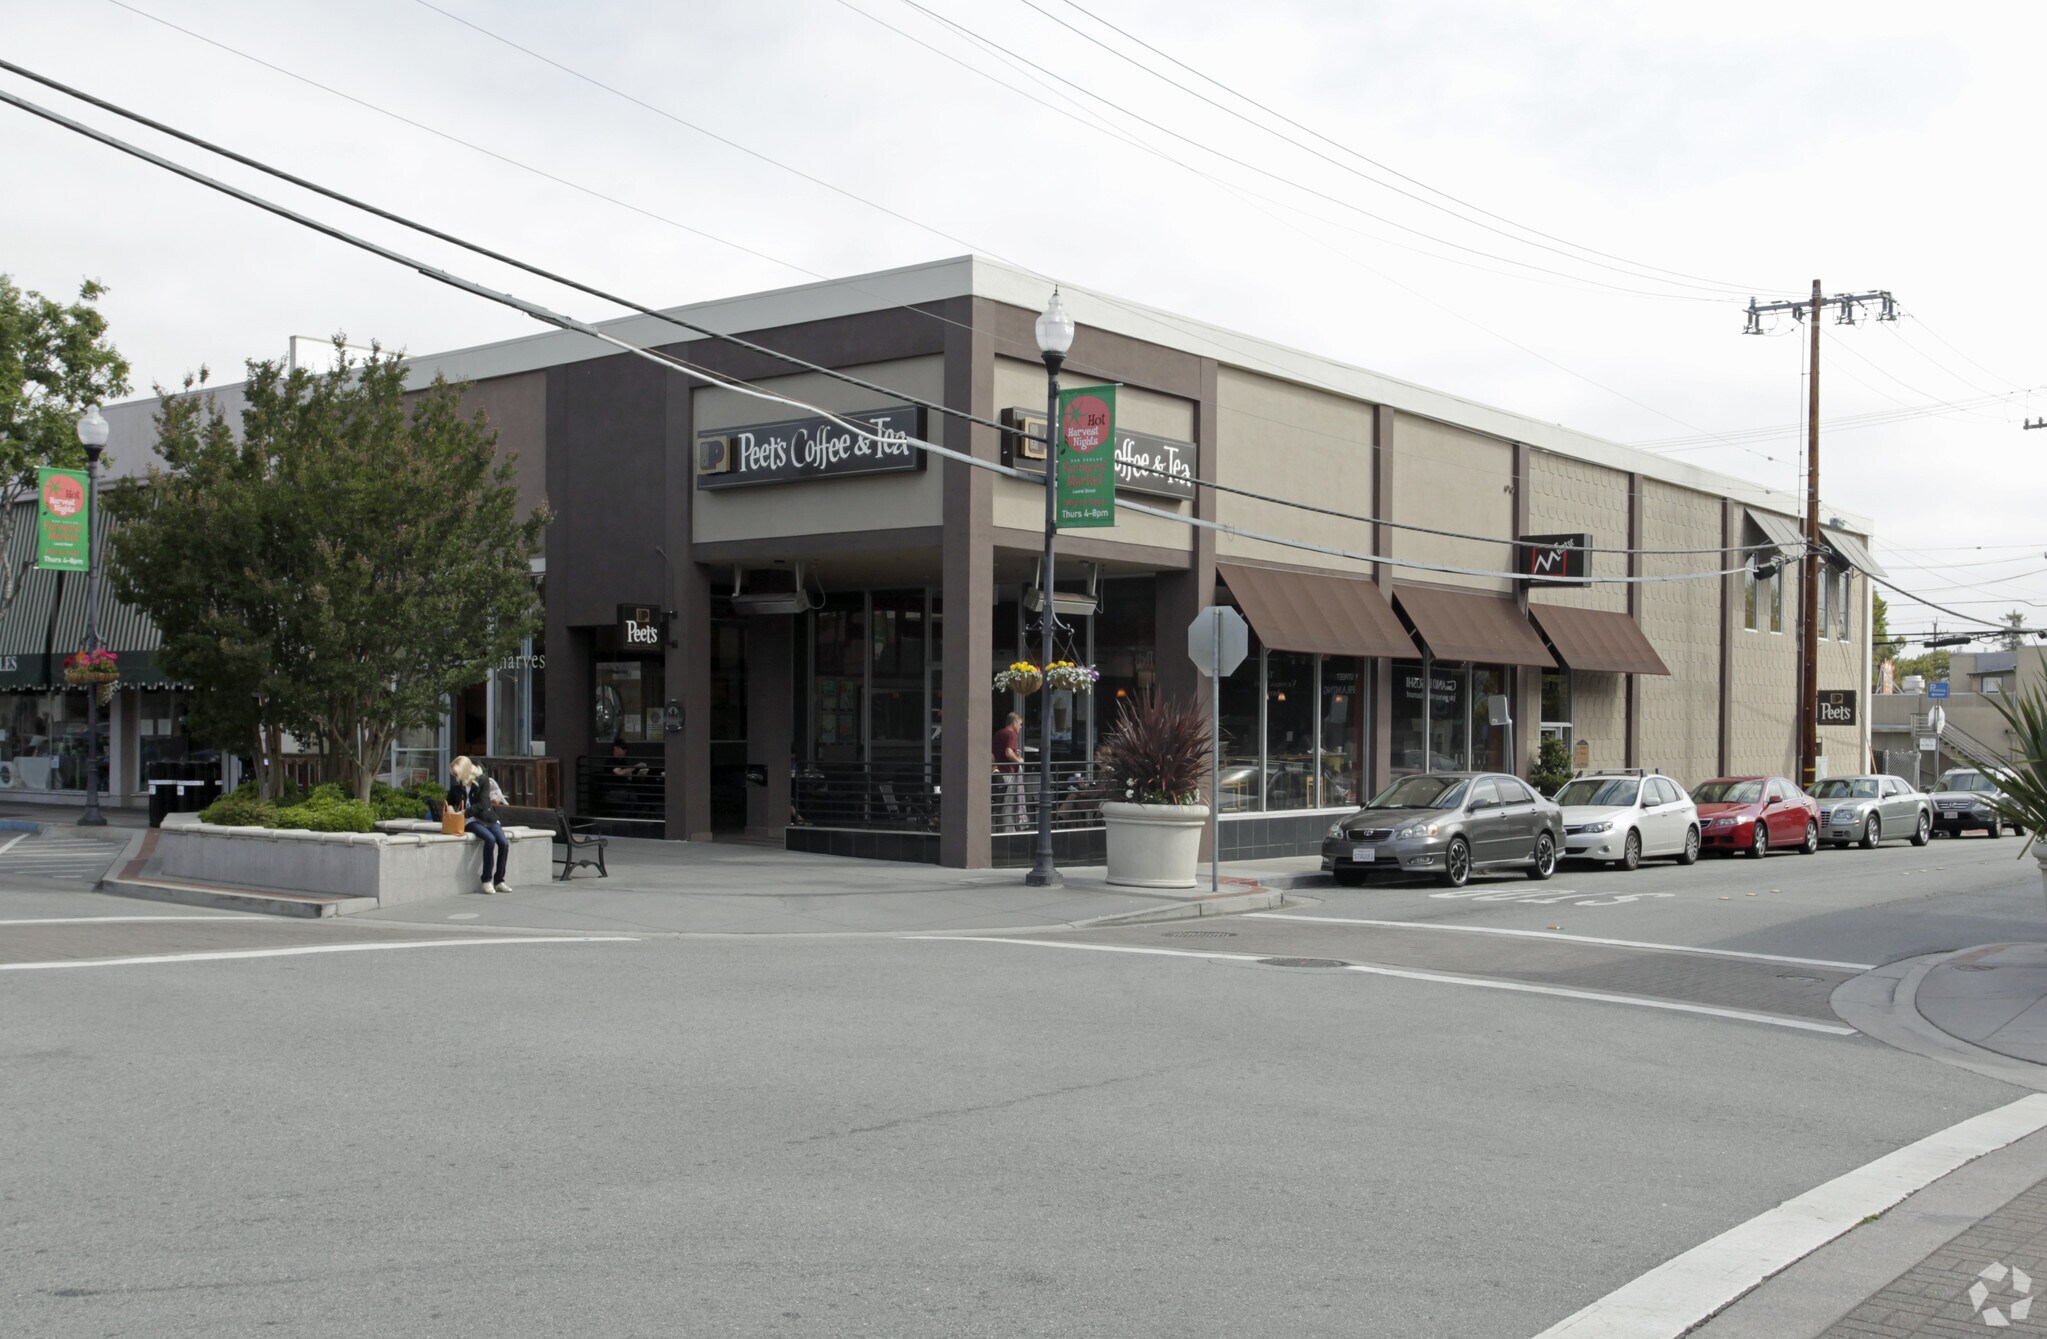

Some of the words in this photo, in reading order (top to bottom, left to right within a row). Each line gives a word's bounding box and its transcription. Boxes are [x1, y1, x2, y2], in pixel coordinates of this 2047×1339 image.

[1088, 414, 1105, 426] Hot
[1067, 426, 1099, 437] Harvest
[738, 432, 786, 472] Peet's
[791, 425, 850, 469] Coffee
[854, 433, 872, 455] &
[870, 417, 909, 458] Tea
[1073, 437, 1099, 451] Nights
[1114, 438, 1150, 482] offee
[1152, 454, 1168, 475] &
[1164, 445, 1191, 487] Tea
[1062, 509, 1082, 518] Thurs
[626, 620, 658, 644] Peet's
[1820, 702, 1851, 721] Peet's
